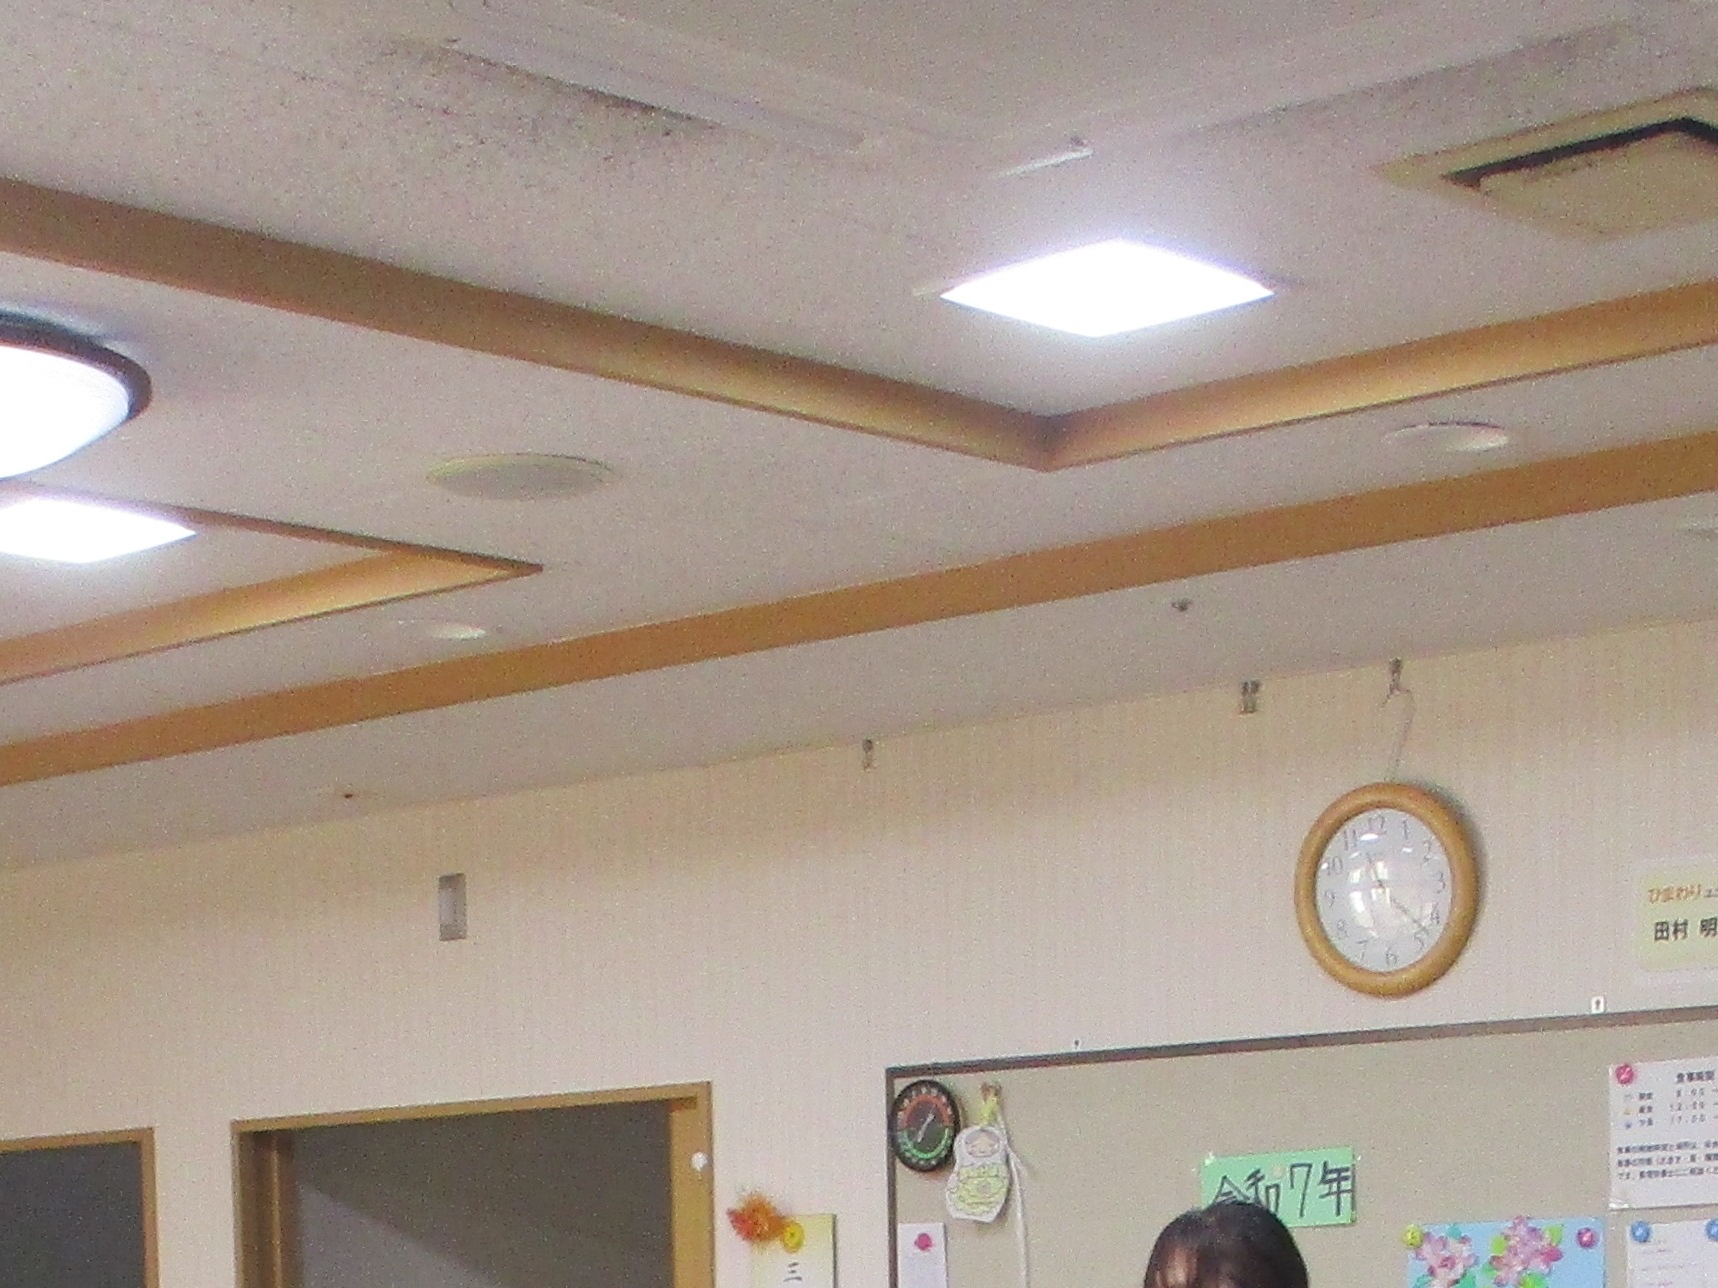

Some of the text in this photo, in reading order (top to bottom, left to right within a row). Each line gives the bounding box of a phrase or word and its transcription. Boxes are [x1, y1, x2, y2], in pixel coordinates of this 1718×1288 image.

[1367, 813, 1387, 835] 12
[1400, 819, 1411, 841] 1
[1343, 828, 1358, 851] 11
[1421, 838, 1433, 864] 2
[1436, 870, 1447, 895] 3
[1323, 887, 1336, 909] 9
[1335, 918, 1349, 940] 8
[1653, 916, 1690, 942] 田村
[1355, 939, 1369, 962] 7
[1384, 946, 1399, 967] 6
[783, 1261, 804, 1283] 三
